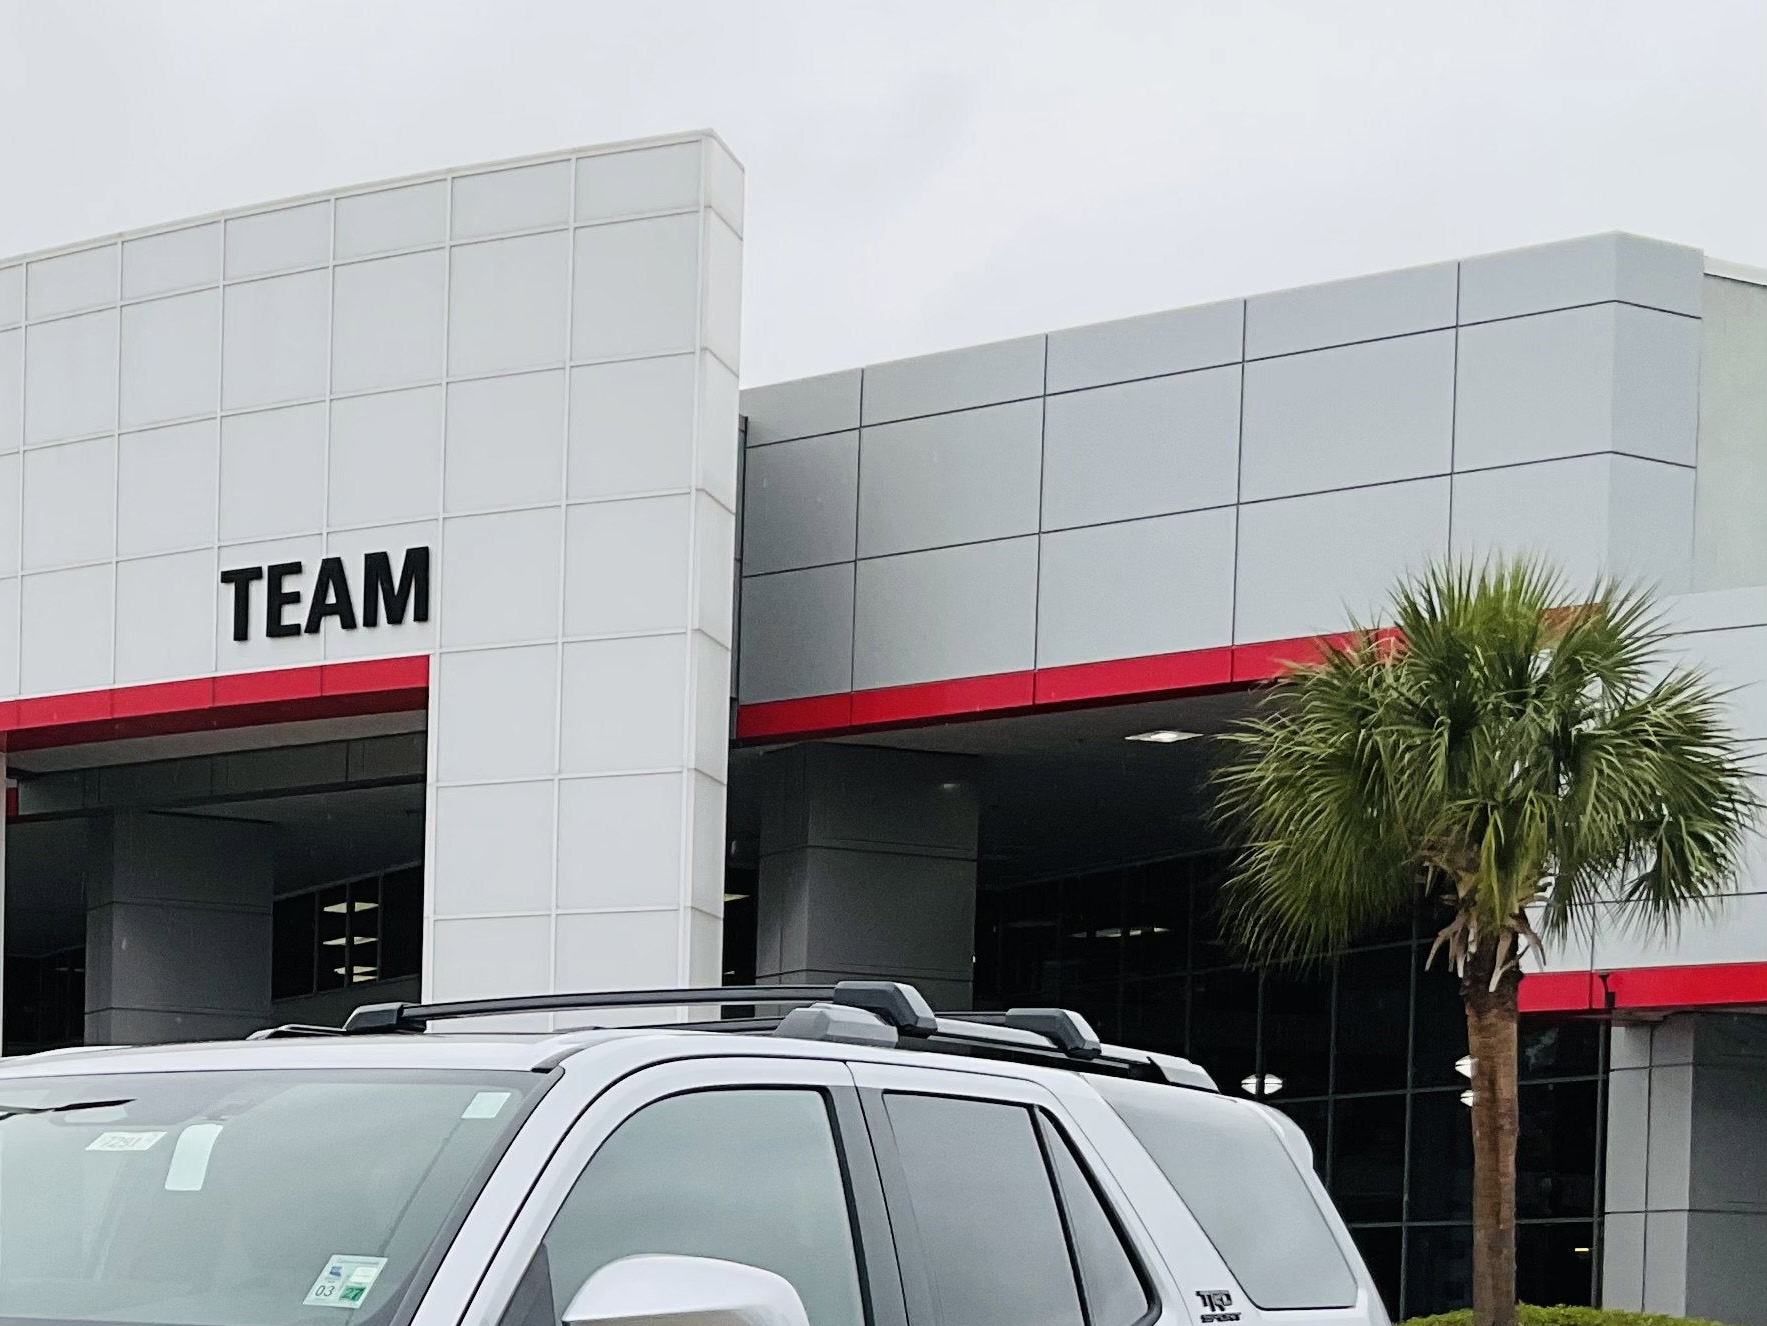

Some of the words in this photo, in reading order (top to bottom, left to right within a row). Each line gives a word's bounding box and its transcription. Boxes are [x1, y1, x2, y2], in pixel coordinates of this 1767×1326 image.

[220, 546, 430, 642] TEAM
[314, 1285, 336, 1297] 03
[340, 1286, 366, 1301] 27
[1195, 1290, 1233, 1312] TRD
